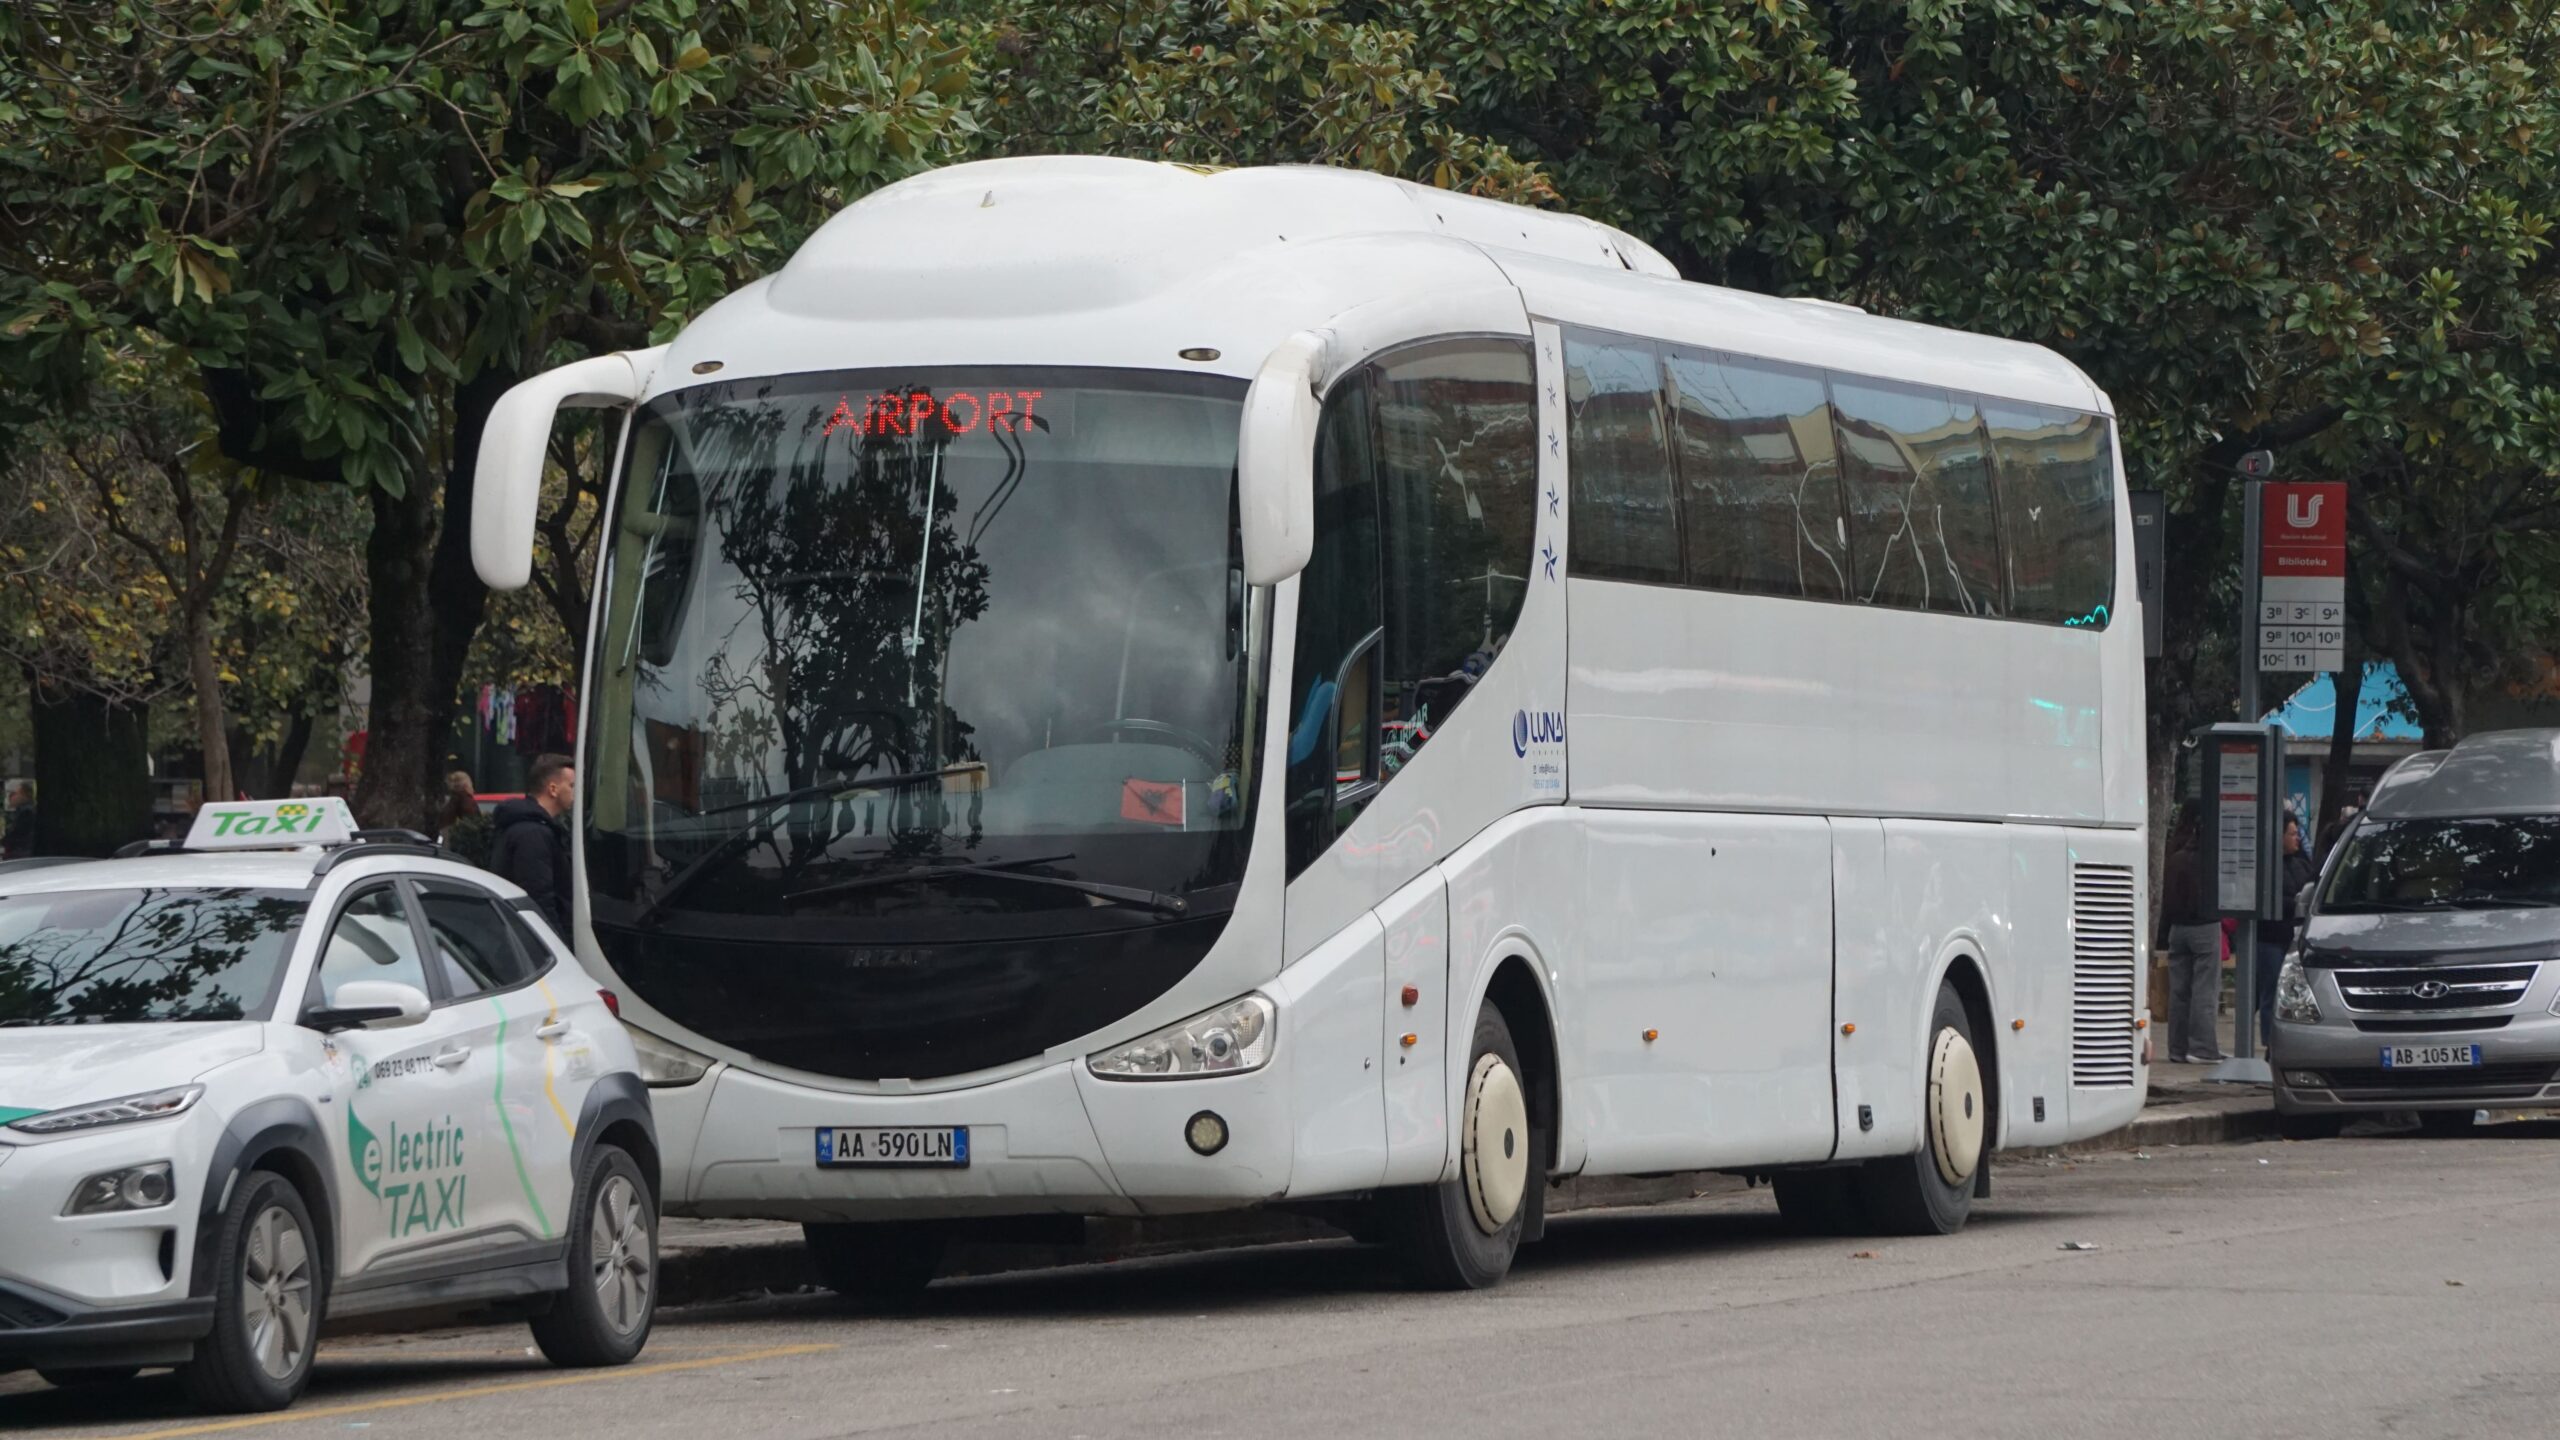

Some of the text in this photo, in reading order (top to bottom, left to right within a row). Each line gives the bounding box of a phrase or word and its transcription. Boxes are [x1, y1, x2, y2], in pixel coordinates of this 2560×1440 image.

[824, 391, 1043, 436] AIRPORT
[2279, 557, 2327, 566] Biblioteka
[2294, 654, 2306, 666] 11
[1530, 711, 1564, 743] LUNA
[211, 807, 326, 837] Taxi
[374, 1061, 391, 1079] 069
[392, 1059, 403, 1077] 23
[2395, 1048, 2414, 1064] AB
[838, 1132, 865, 1158] AA
[384, 1174, 466, 1239] TAXI
